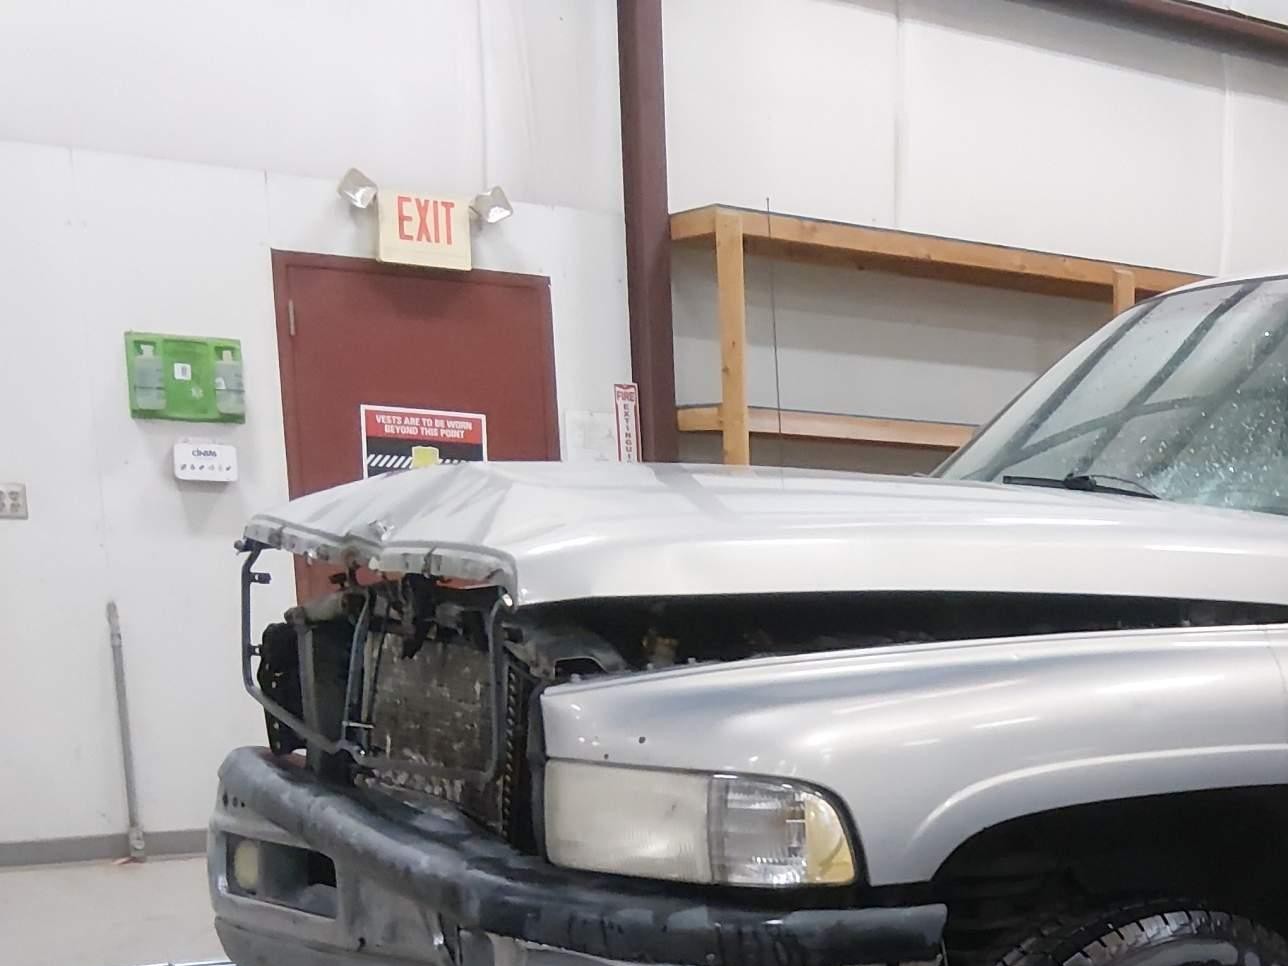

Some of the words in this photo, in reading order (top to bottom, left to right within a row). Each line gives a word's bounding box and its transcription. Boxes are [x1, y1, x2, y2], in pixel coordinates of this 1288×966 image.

[398, 196, 455, 245] EXIT
[616, 391, 635, 401] FIRE
[376, 414, 402, 424] VESTS
[403, 417, 421, 426] ARE
[421, 418, 434, 427] TO
[434, 419, 446, 428] BE
[446, 420, 473, 431] WORN
[384, 424, 418, 435] BEYOND
[420, 427, 438, 437] THIS
[440, 429, 465, 439] POINT
[623, 404, 633, 463] EXTINGUI
